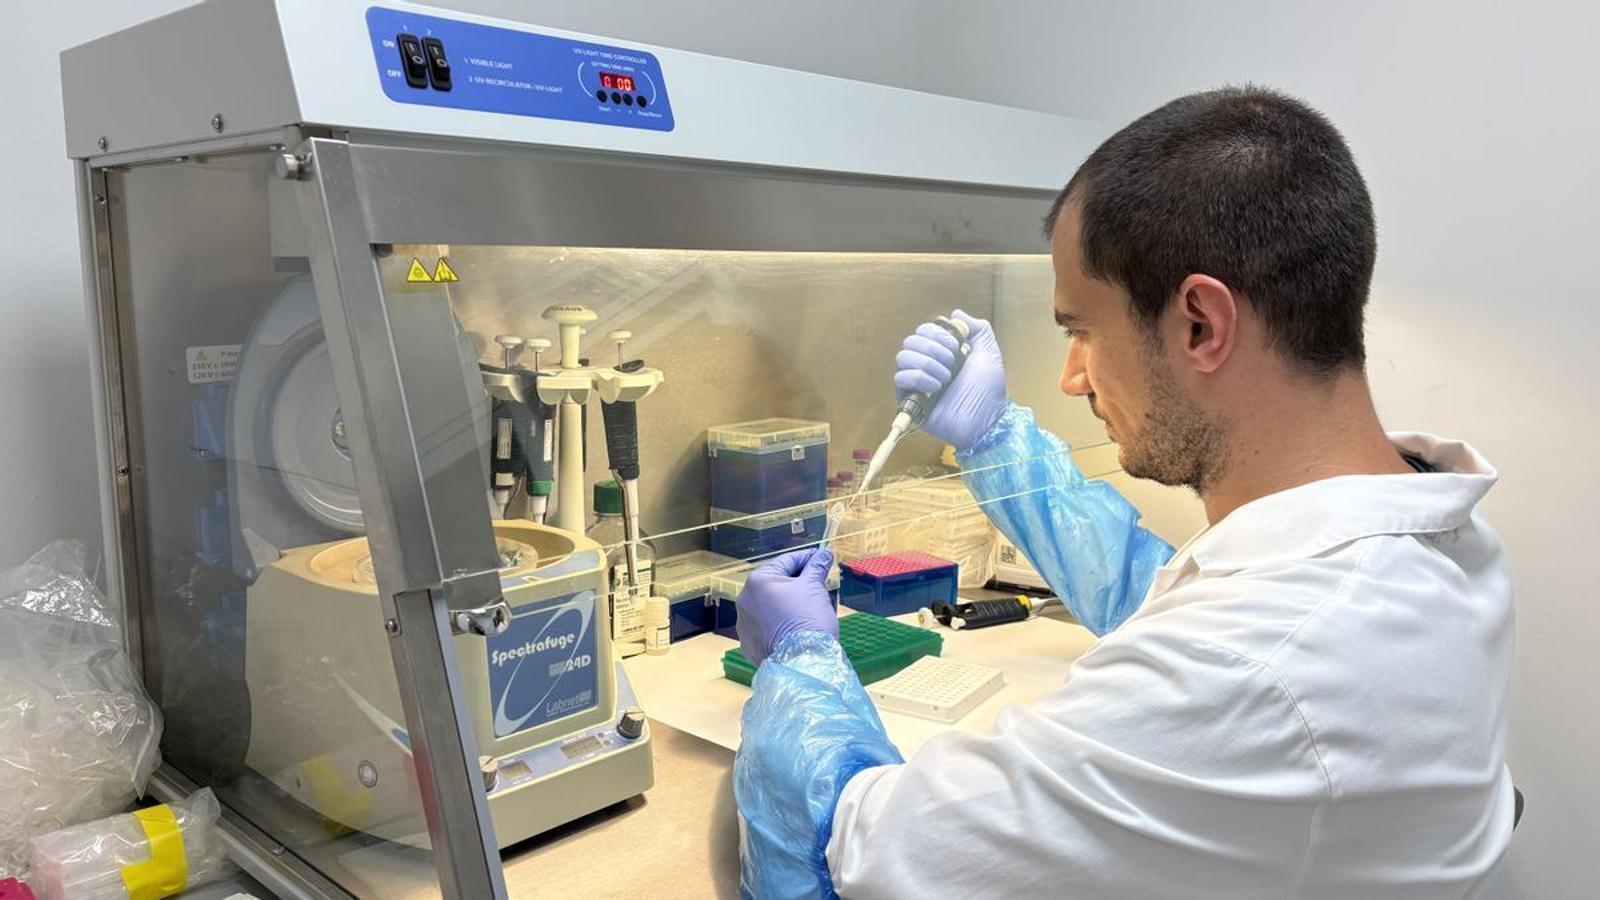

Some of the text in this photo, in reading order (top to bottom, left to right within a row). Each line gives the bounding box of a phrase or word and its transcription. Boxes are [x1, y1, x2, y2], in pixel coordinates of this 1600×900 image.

[382, 40, 395, 48] ON
[469, 58, 494, 67] VISIBLE
[495, 61, 513, 70] LIGHT
[491, 633, 575, 667] Spectrafuge
[565, 655, 592, 673] 24D
